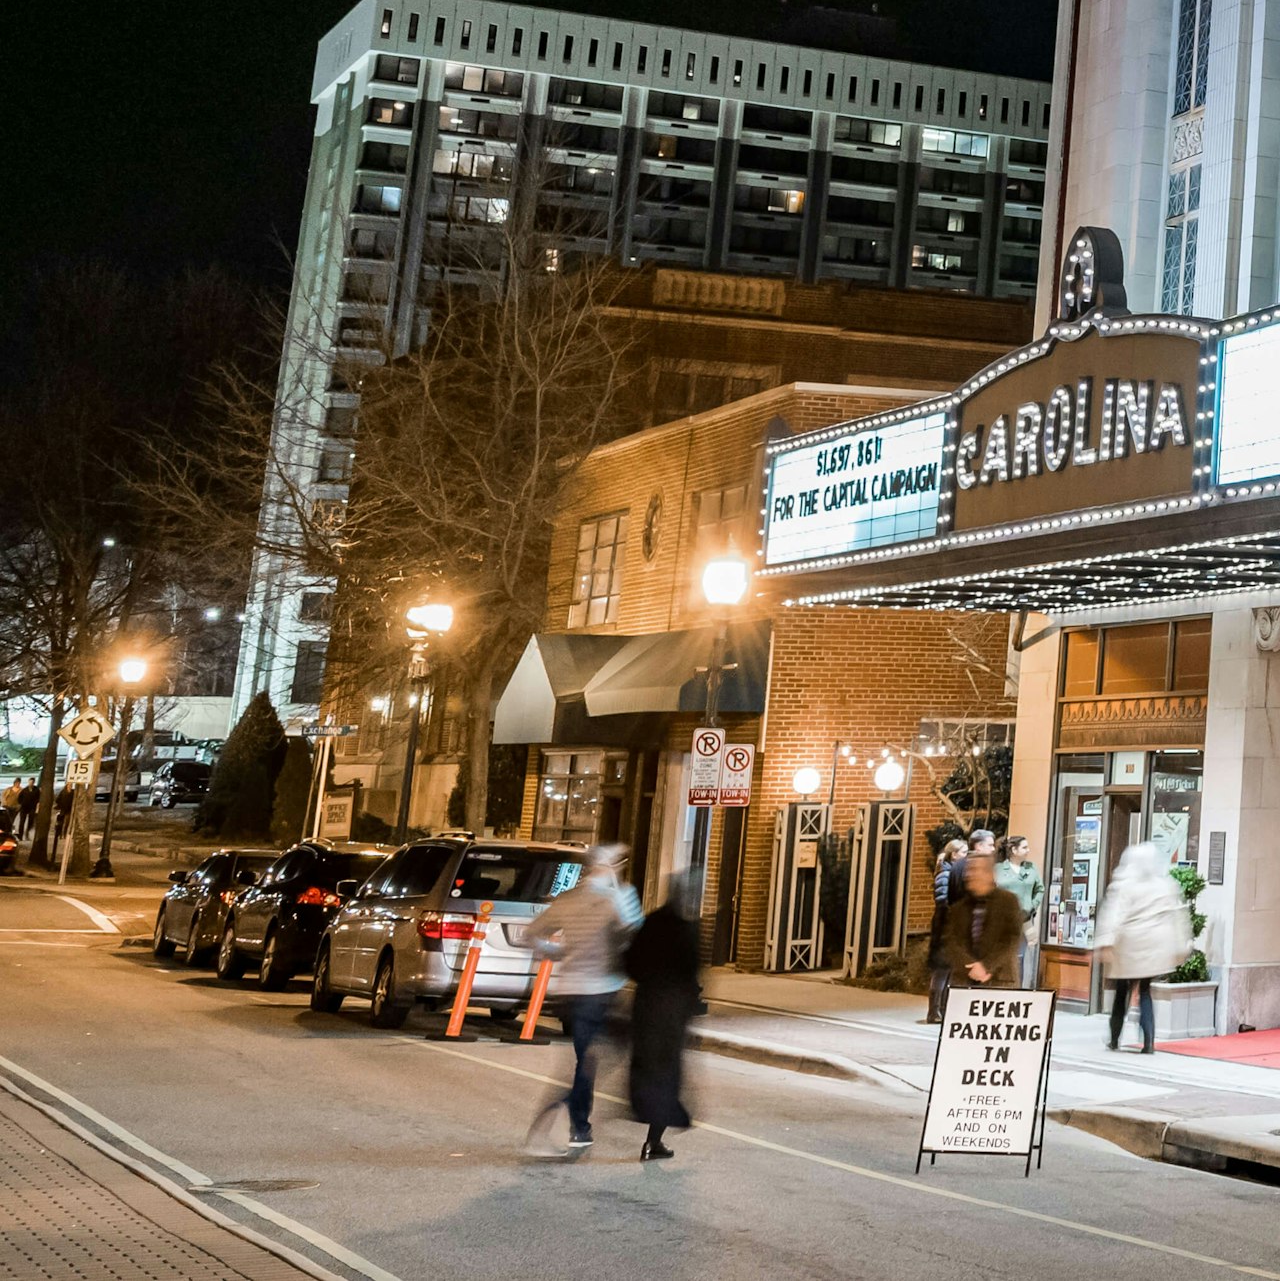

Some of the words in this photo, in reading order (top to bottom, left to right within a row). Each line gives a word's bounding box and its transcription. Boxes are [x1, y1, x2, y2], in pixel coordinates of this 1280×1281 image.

[956, 376, 1191, 490] CAROLINA
[773, 494, 795, 522] FOR
[798, 488, 820, 518] THE
[823, 477, 869, 511] CAPITAL
[871, 462, 939, 502] CAMPAIGN
[74, 763, 89, 774] 15
[690, 790, 717, 798] TOW-IN
[722, 790, 749, 798] TOW-IN
[969, 999, 1034, 1019] EVENT
[949, 1022, 1041, 1042] PARKING
[984, 1046, 1011, 1063] IN
[961, 1069, 1015, 1087] DECK
[947, 1108, 988, 1119] AFTER
[994, 1109, 1001, 1119] 6
[1004, 1110, 1023, 1120] PM
[954, 1122, 980, 1133] AND
[988, 1123, 1007, 1133] ON
[942, 1136, 1011, 1149] WEEKENDS
